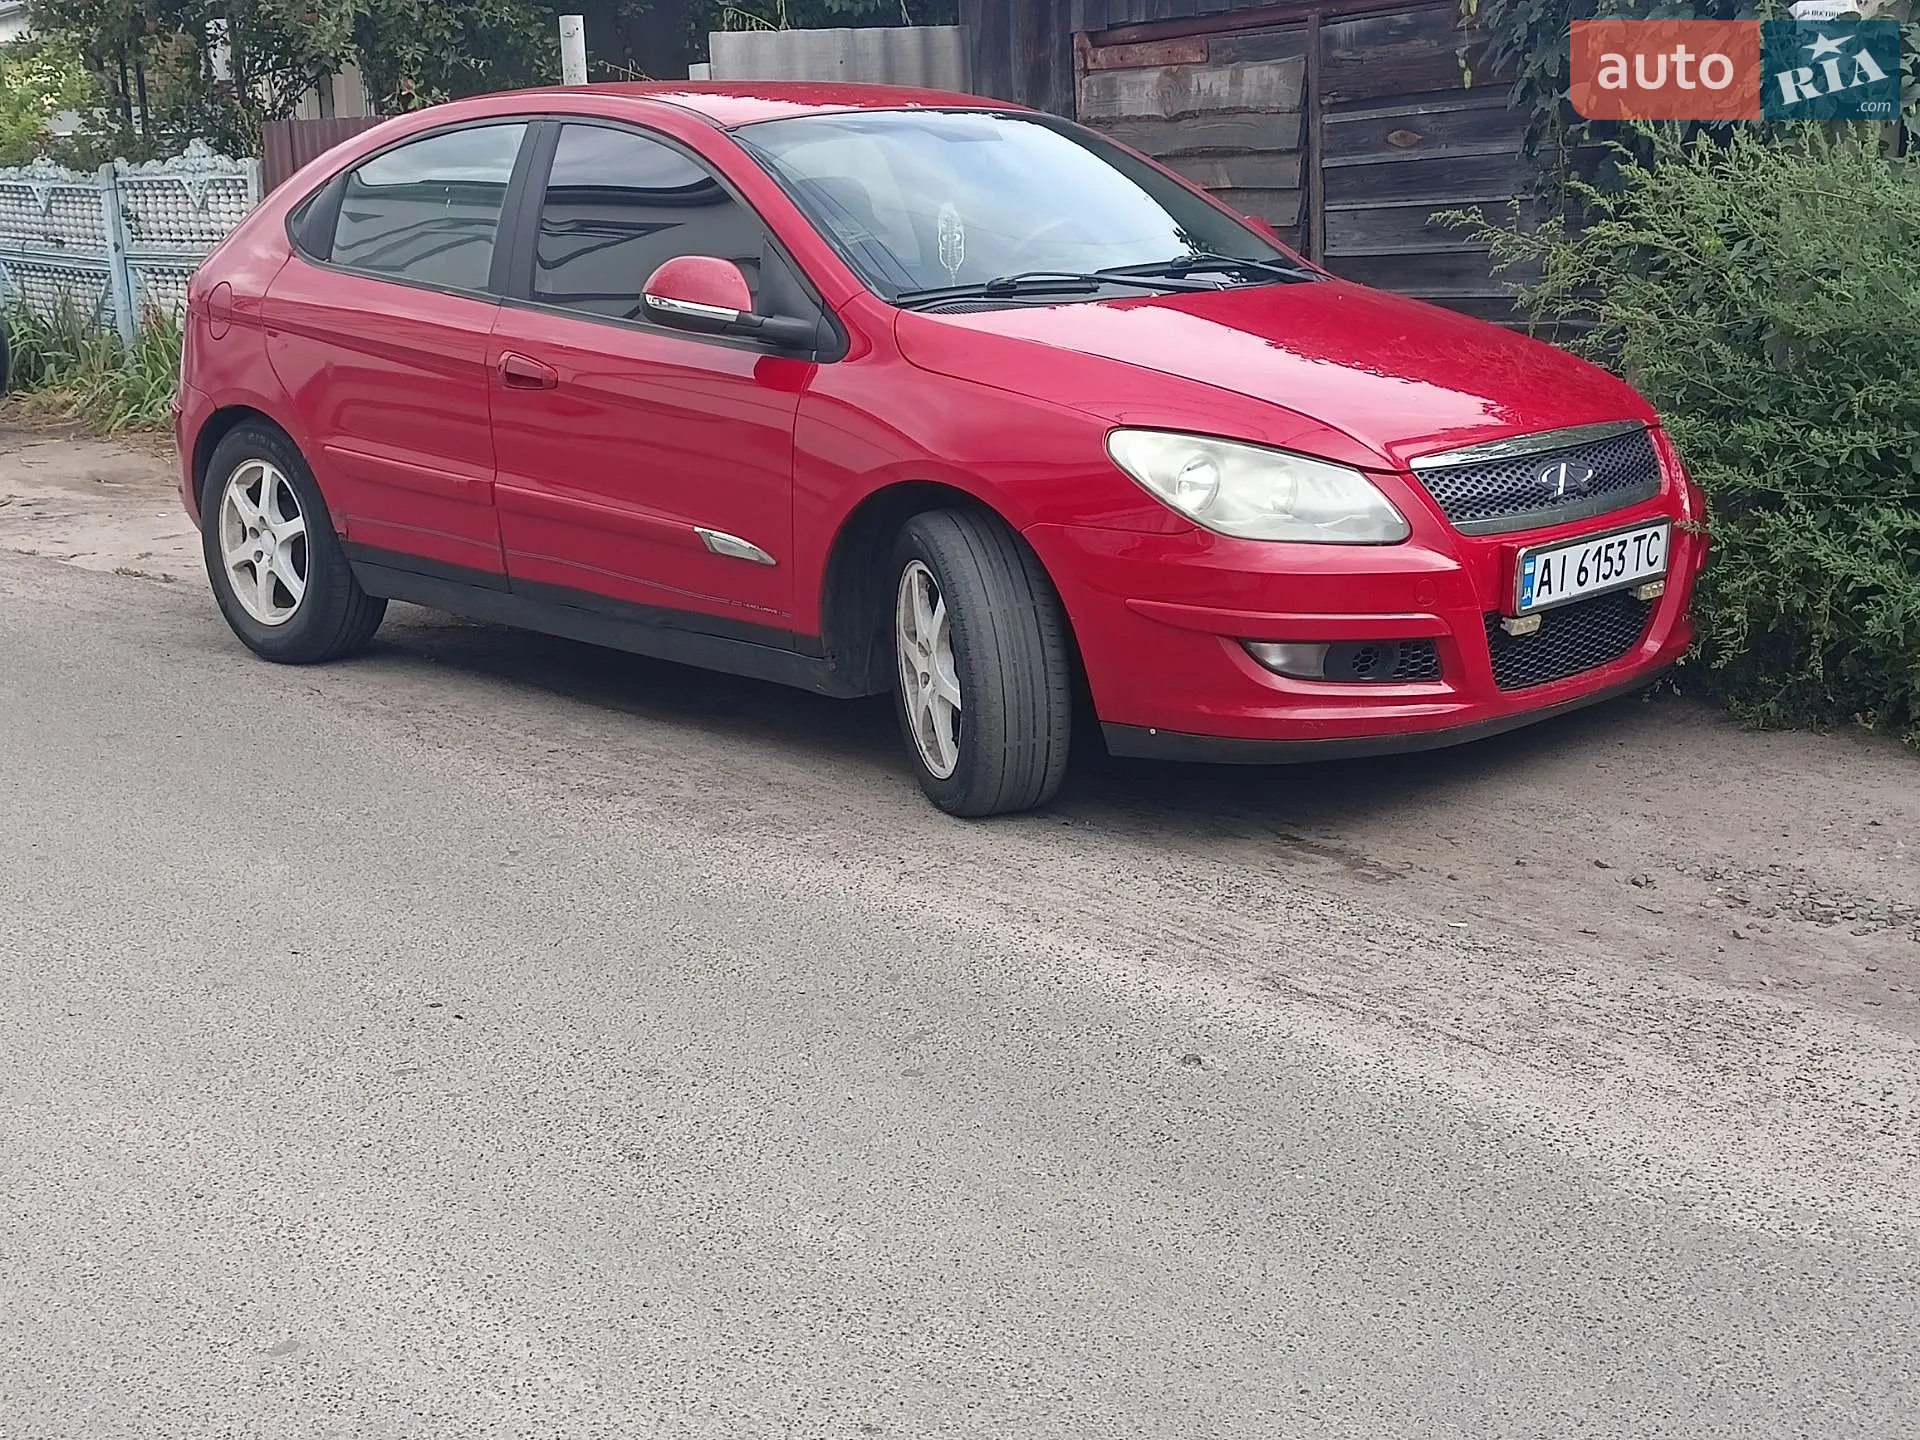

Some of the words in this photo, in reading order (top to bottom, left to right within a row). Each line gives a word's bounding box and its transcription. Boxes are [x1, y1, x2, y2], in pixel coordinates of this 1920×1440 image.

[1536, 554, 1566, 597] AI
[1576, 539, 1627, 587] 6153
[1633, 531, 1660, 571] TC
